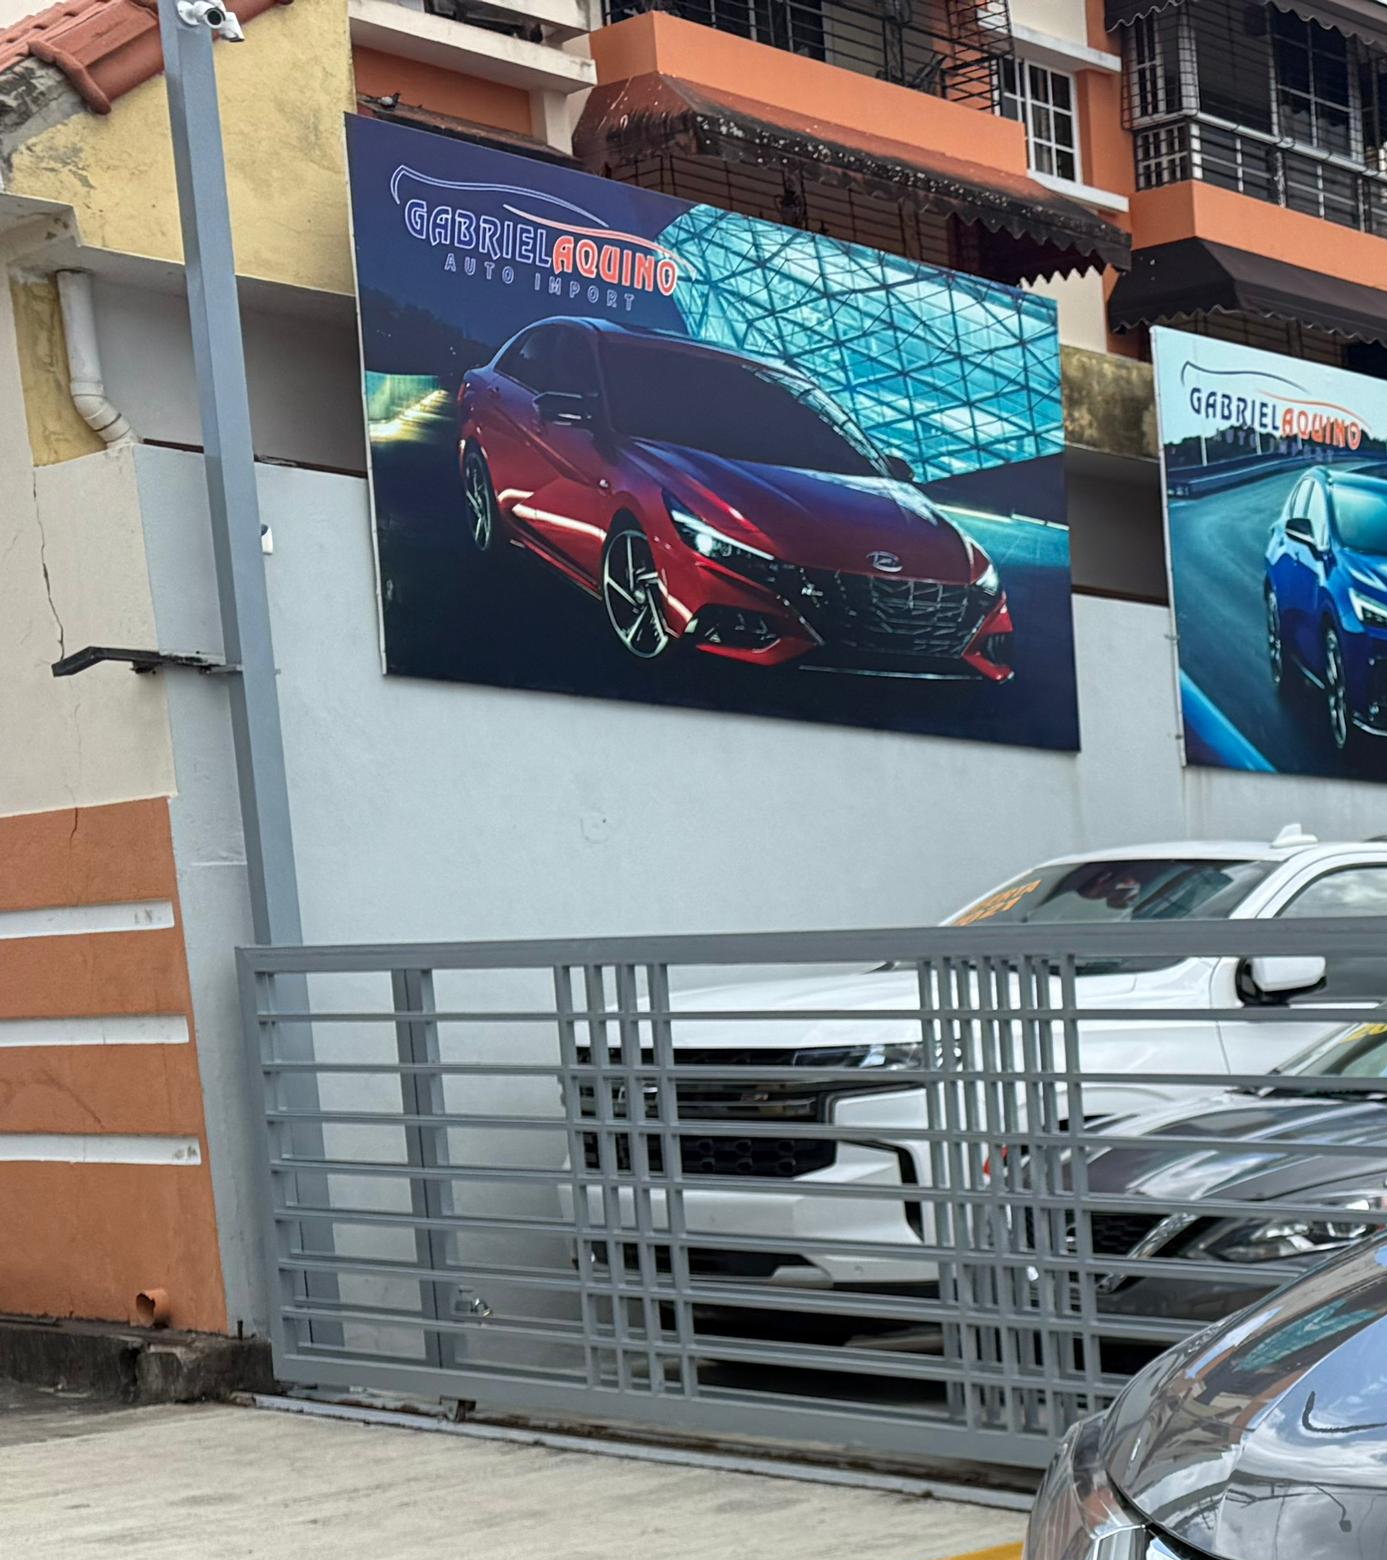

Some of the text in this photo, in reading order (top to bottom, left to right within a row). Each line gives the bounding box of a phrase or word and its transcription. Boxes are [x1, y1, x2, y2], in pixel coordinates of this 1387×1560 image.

[404, 198, 678, 297] GABRIEL AQUINO
[444, 252, 636, 312] AUTO IMPORT
[1189, 386, 1362, 451] GABRIEL AQUINO
